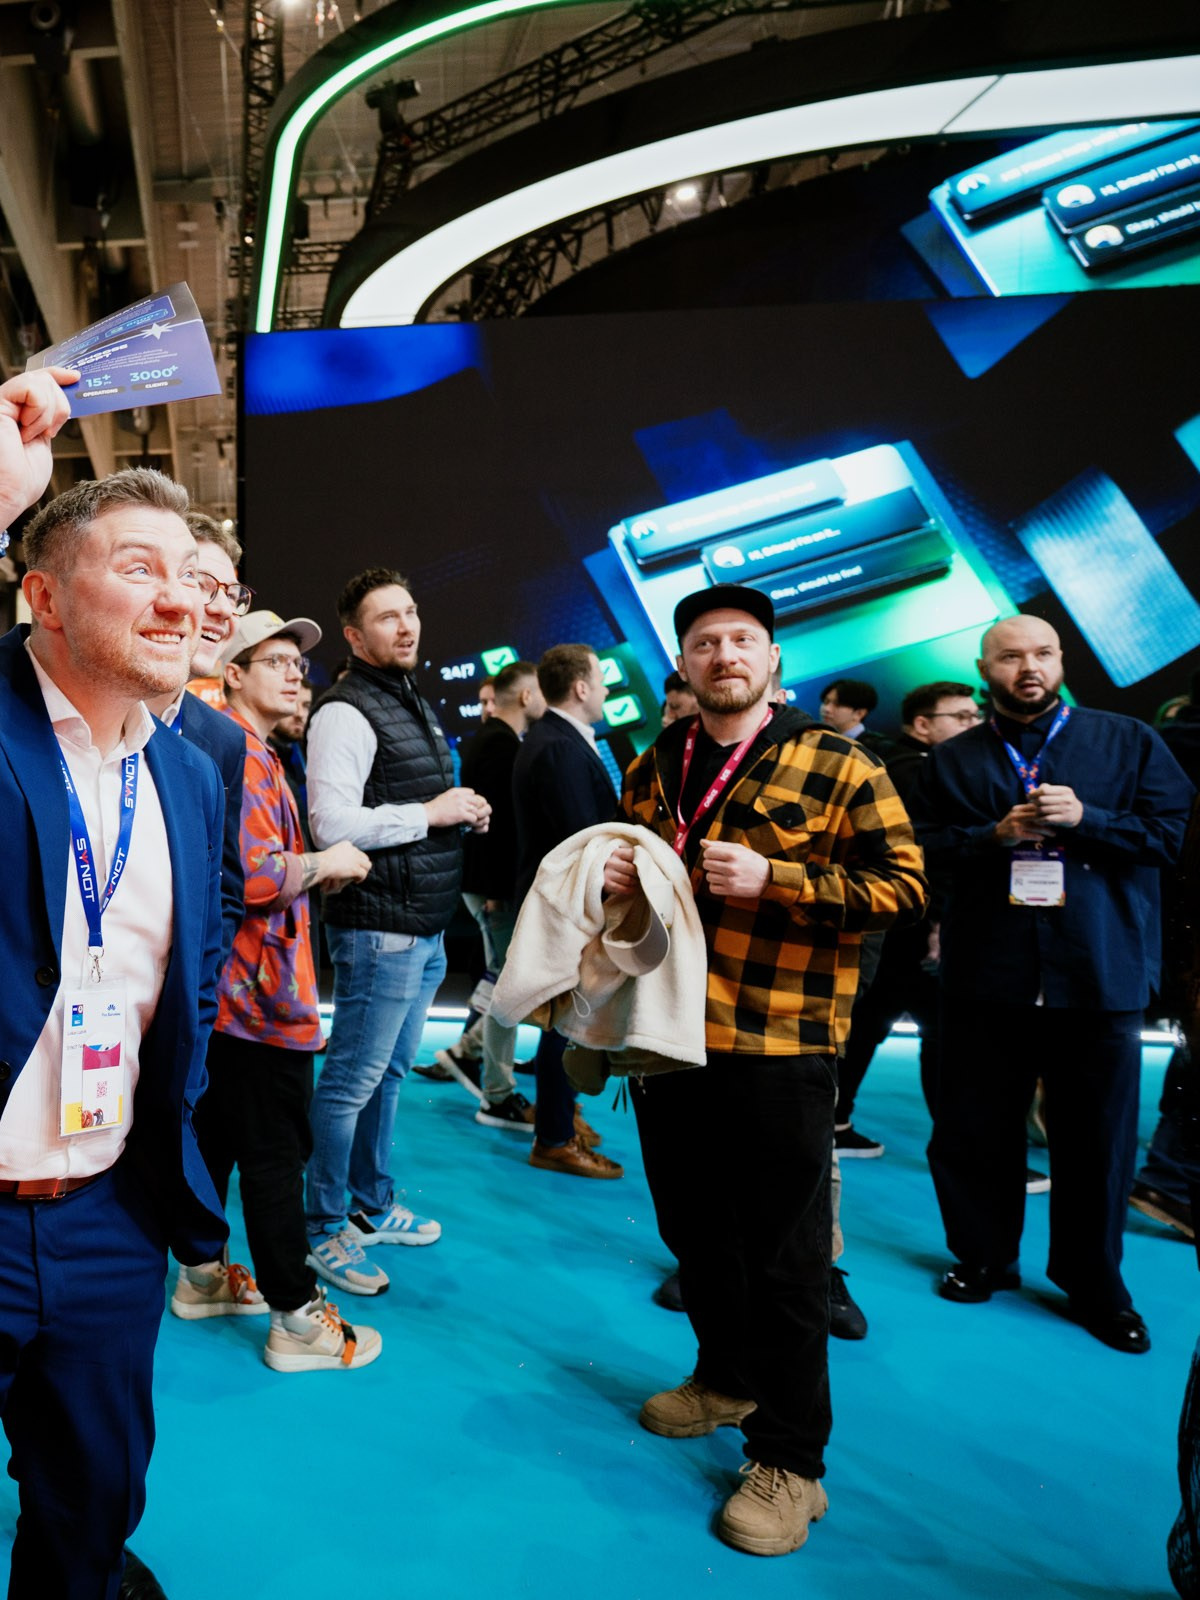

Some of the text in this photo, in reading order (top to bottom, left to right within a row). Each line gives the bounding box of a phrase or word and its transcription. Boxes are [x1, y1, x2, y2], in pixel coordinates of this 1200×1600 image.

[130, 365, 178, 382] 3000+
[83, 388, 118, 398] OPERATIONS
[145, 381, 168, 389] CLIENTS
[440, 663, 475, 680] 24/7
[124, 757, 136, 808] SYNOT
[77, 838, 95, 903] SYNOT
